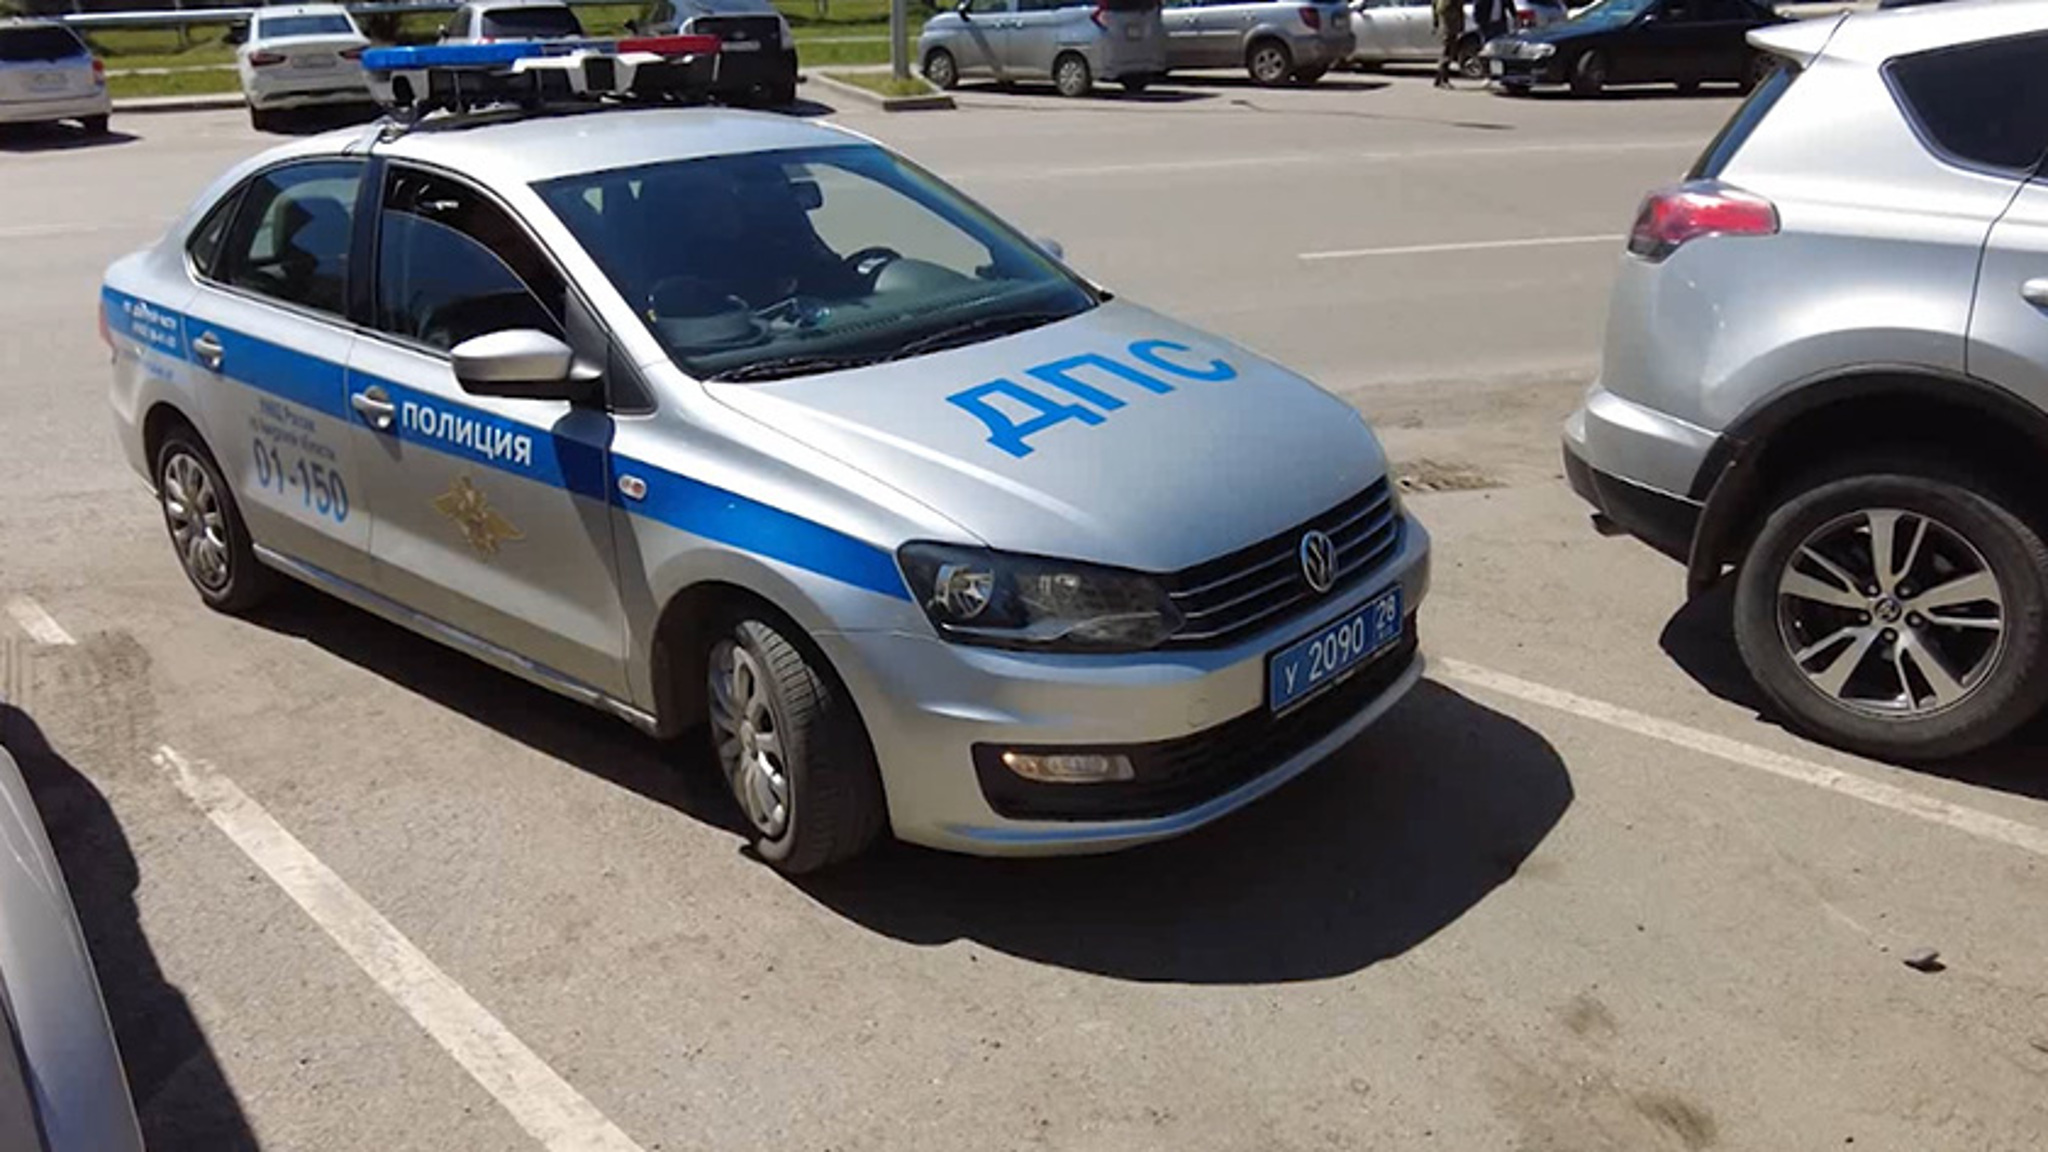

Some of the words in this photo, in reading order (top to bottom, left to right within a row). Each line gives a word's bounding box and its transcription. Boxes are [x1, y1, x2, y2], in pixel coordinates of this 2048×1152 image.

[402, 401, 532, 467] ПОЛИЦИЯ
[945, 339, 1238, 458] ДПС
[253, 437, 349, 523] 01-150
[1308, 615, 1364, 682] 2090
[1376, 594, 1396, 630] 28
